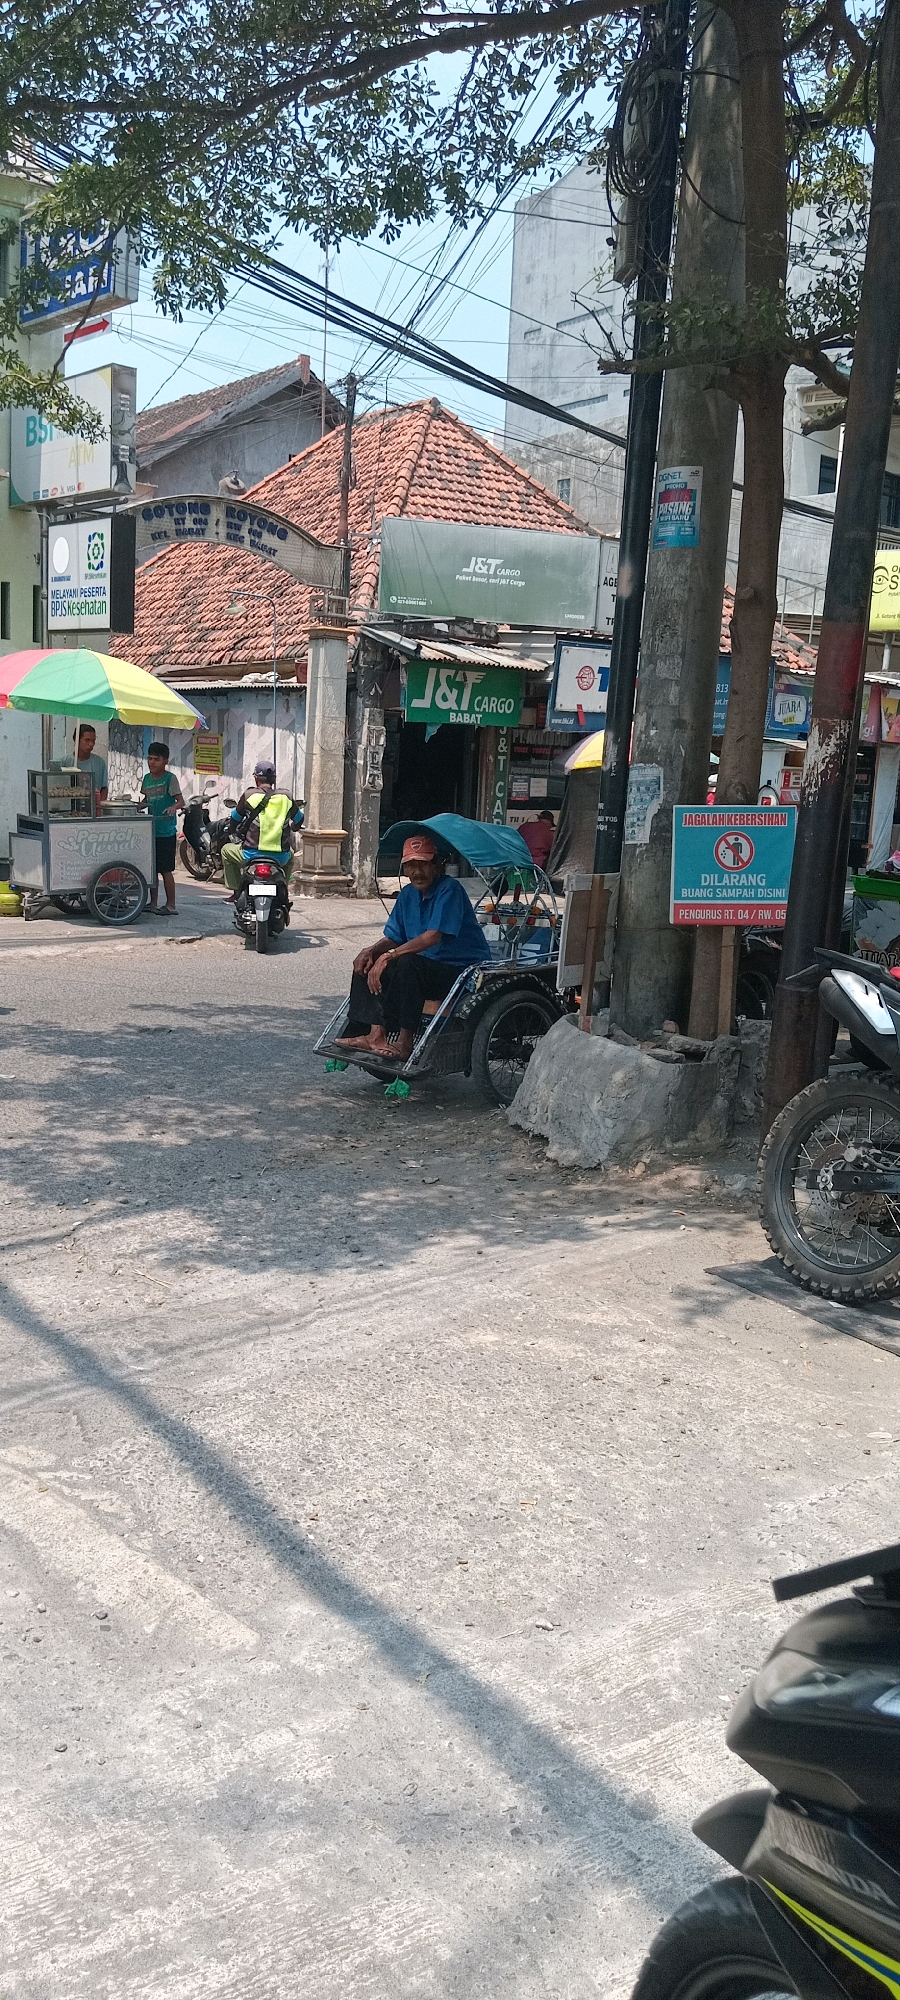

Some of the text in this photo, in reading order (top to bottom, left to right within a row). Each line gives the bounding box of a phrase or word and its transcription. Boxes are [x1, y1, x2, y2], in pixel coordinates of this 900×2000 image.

[26, 415, 54, 448] BSI
[69, 443, 95, 469] ATM
[659, 501, 693, 516] PASANG
[142, 502, 289, 541] GOTONG ROYONG
[461, 556, 521, 577] J&T CARGO
[51, 586, 107, 600] MELAYANI PESERTA
[51, 599, 107, 617] BPJS Kesehatan
[410, 667, 514, 714] J&T CARGO
[777, 699, 802, 716] JUARA
[450, 712, 482, 724] BABAT
[682, 812, 787, 826] JAGALAH KEBERSIHAN
[77, 827, 134, 842] Pentol
[701, 873, 766, 886] DILARANG
[681, 888, 785, 898] BUANG SAMPAH DISINI
[679, 909, 786, 920] PENGURUS RT. 04 / RW. 05
